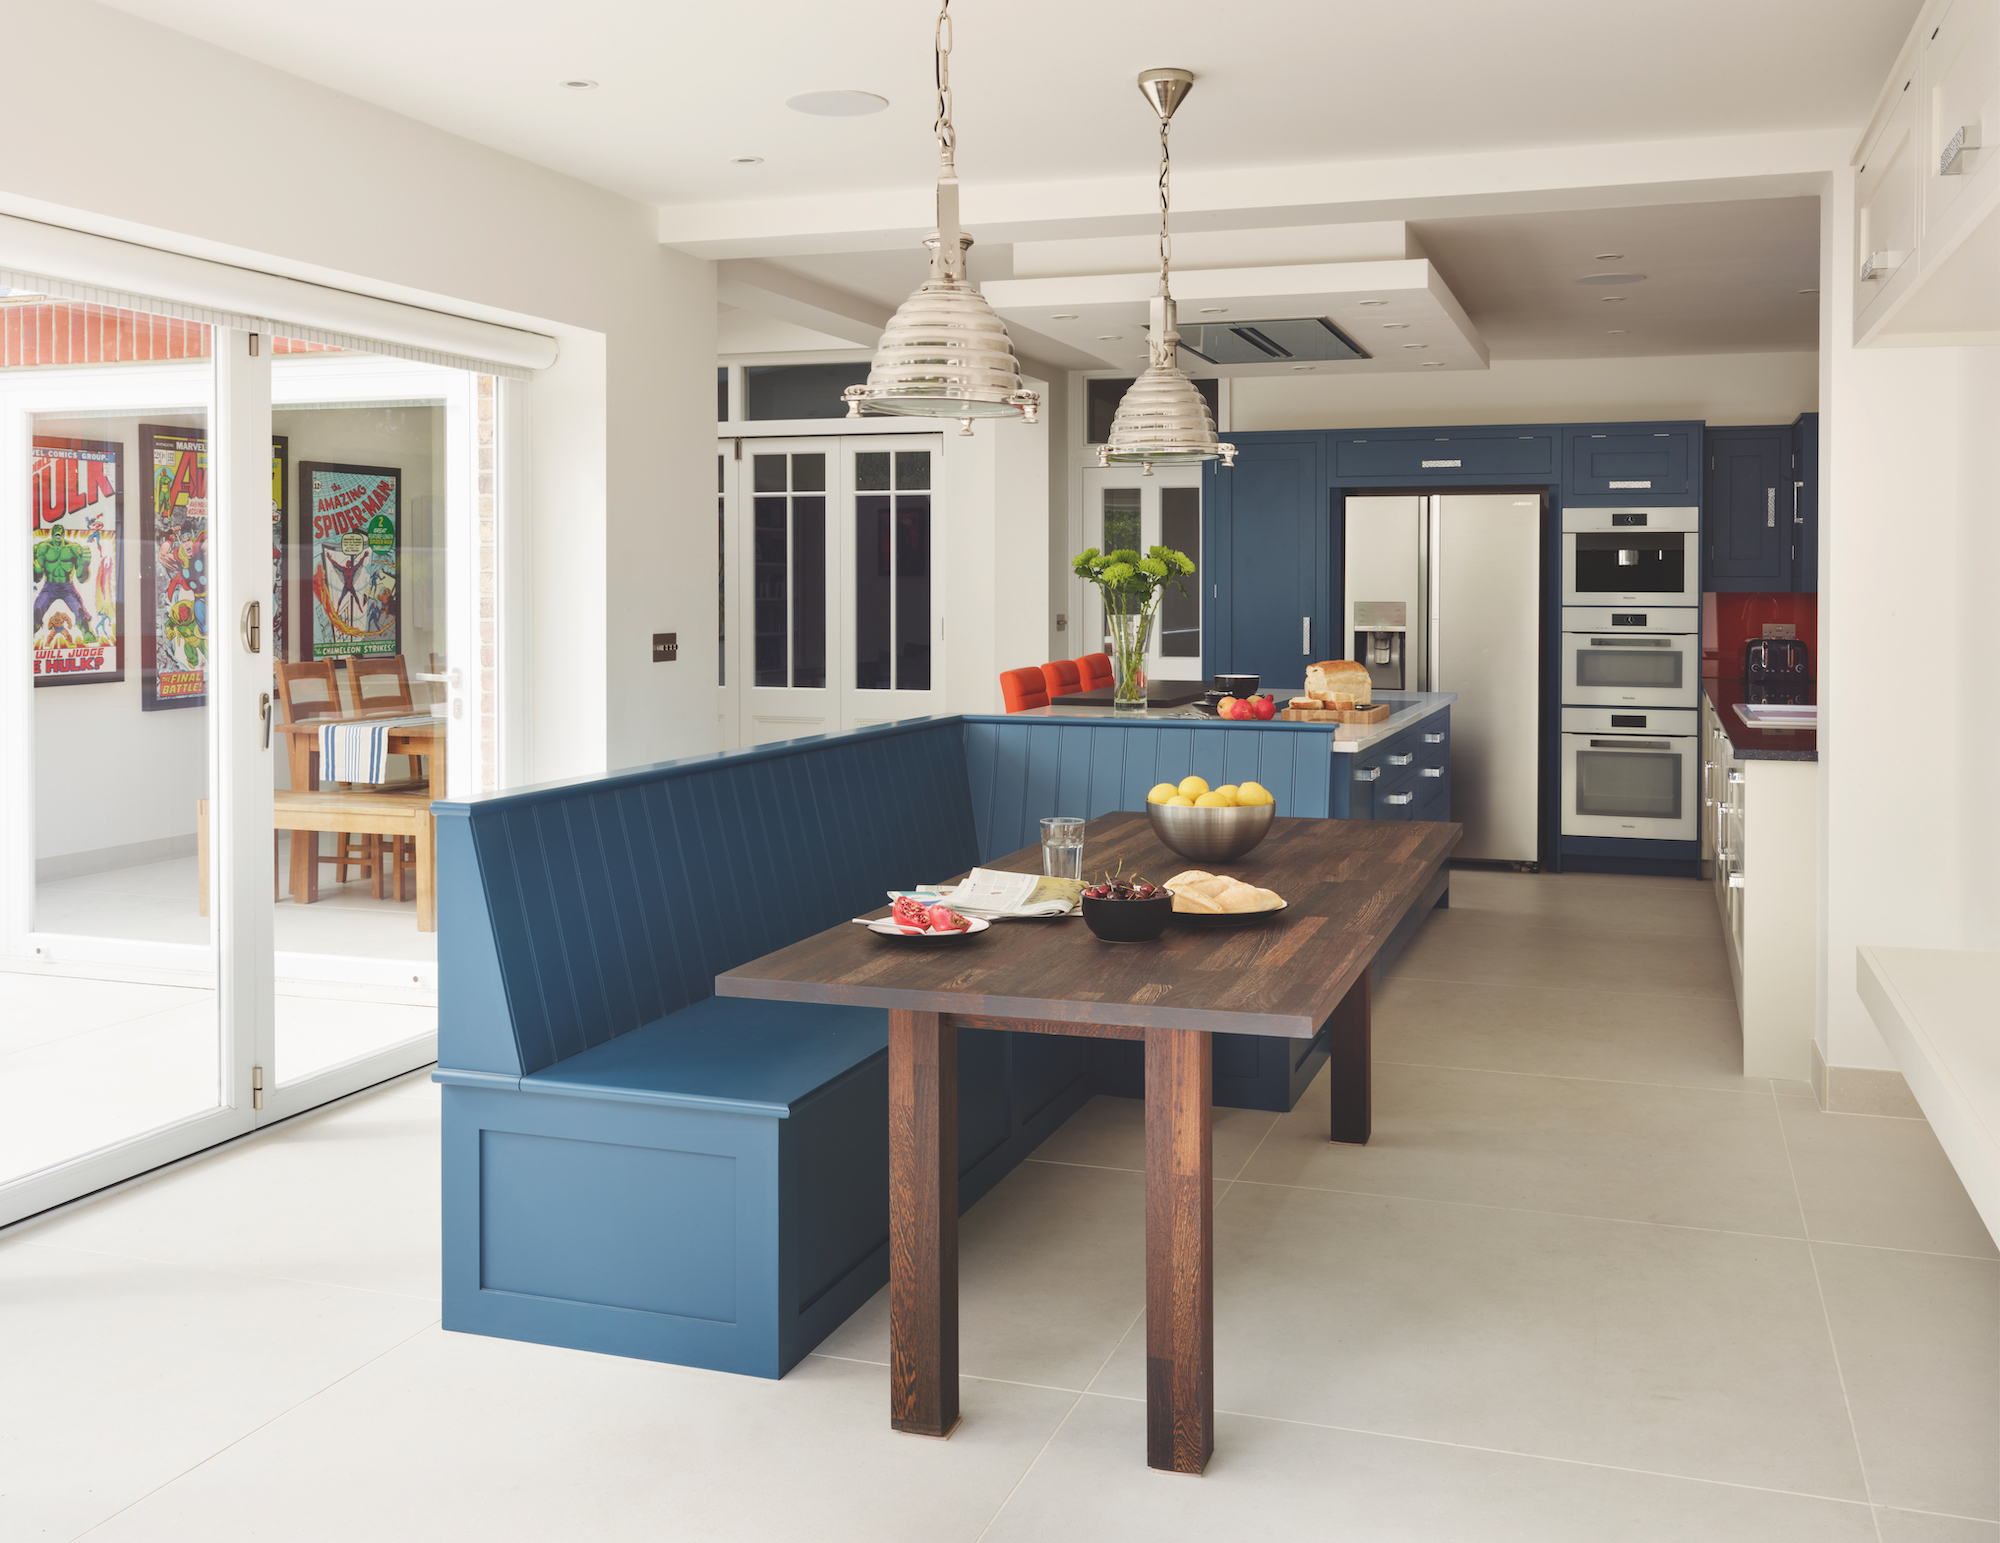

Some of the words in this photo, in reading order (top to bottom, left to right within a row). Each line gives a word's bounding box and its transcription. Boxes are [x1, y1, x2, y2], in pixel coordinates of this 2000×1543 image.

[318, 485, 367, 513] AMAZING
[314, 480, 393, 539] SPIDER-MAN
[378, 516, 384, 527] 2
[35, 650, 63, 659] WILL
[68, 648, 104, 657] JUDGE
[323, 646, 361, 655] CHAMELEON
[46, 657, 104, 673] HULK?
[171, 673, 201, 683] FINAL
[162, 682, 203, 694] BATTLE!
